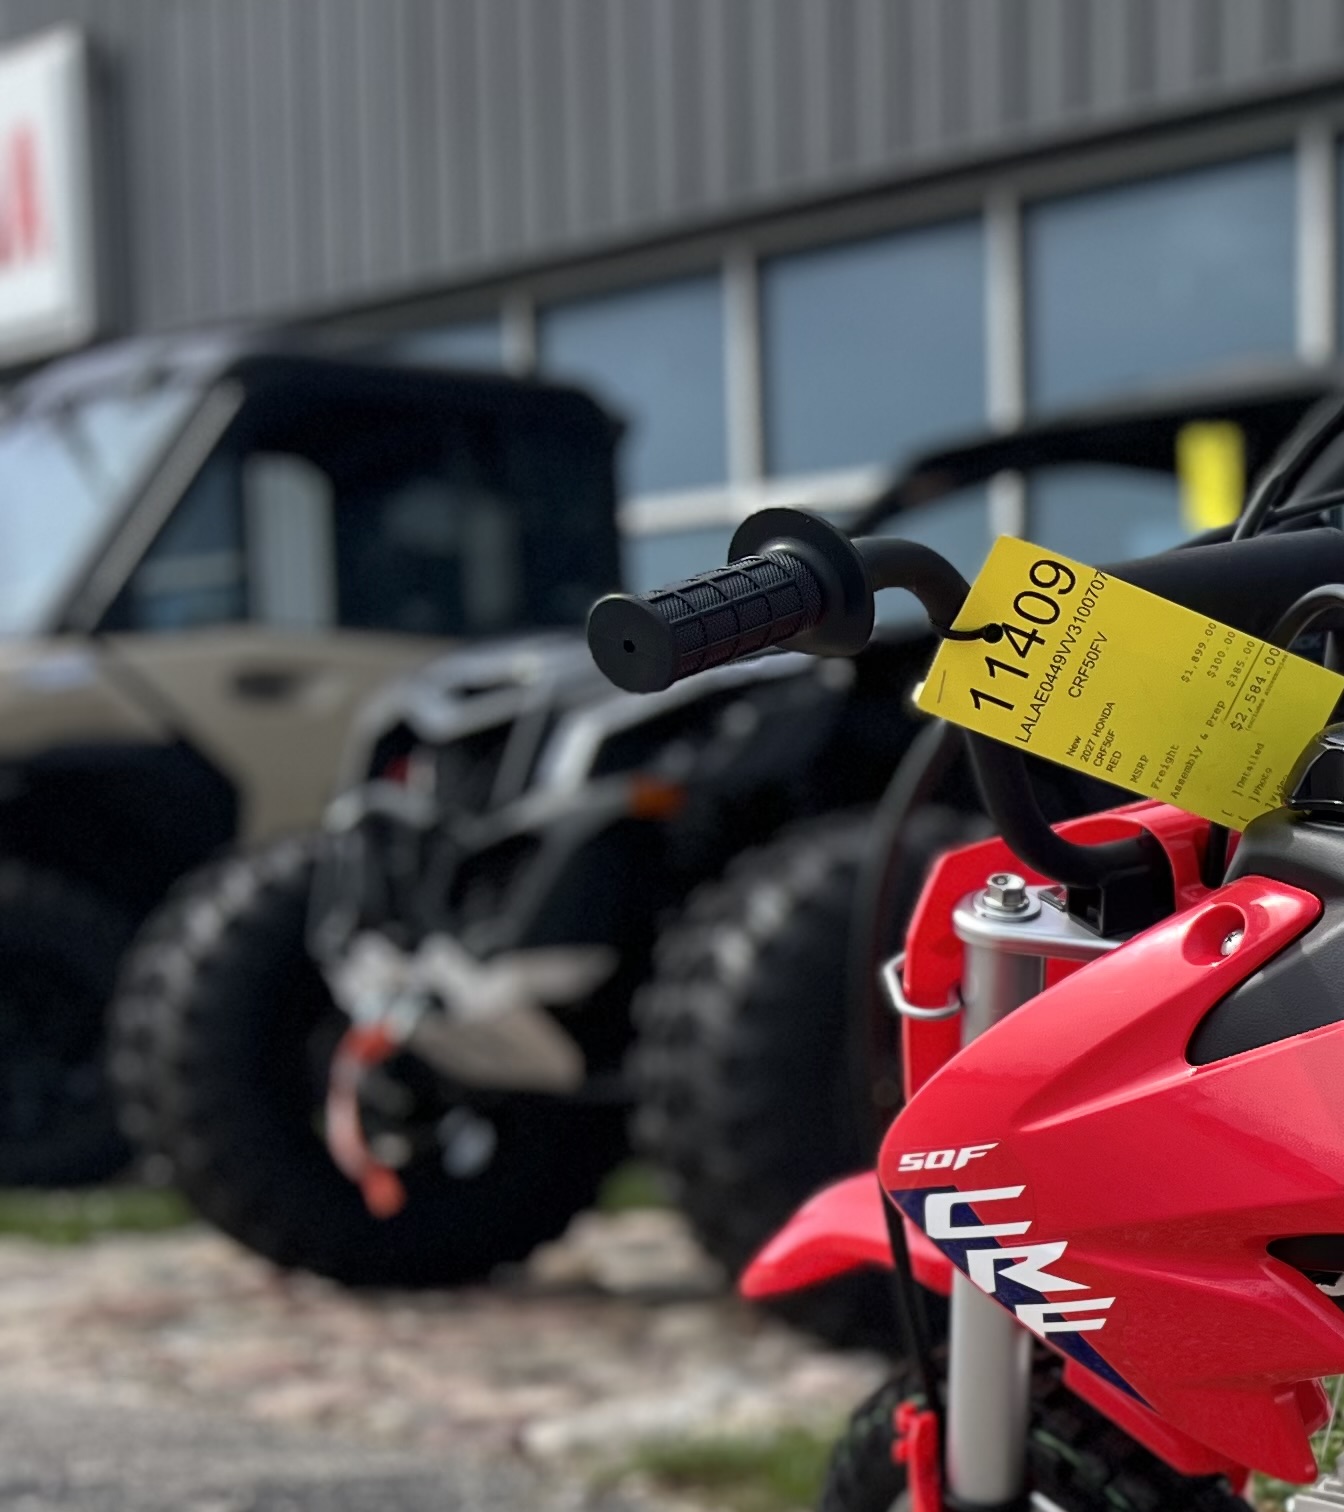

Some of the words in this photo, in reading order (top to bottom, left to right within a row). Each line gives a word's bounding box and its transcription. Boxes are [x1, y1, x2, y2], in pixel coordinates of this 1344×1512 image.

[969, 559, 1075, 710] 11409
[1067, 631, 1107, 697] CRF50FV
[1129, 754, 1148, 783] MSRP
[1180, 622, 1216, 682] $1,899.00
[1150, 744, 1179, 789] Freight
[1206, 631, 1235, 678] $300.00
[1169, 744, 1202, 799] Assembly
[1205, 700, 1225, 727] Prep
[1225, 640, 1255, 687] $385.00
[1229, 647, 1280, 730] $2,584.00
[1065, 735, 1081, 756] New
[1079, 738, 1095, 762] 2027
[1091, 702, 1115, 737] HONDA
[1092, 728, 1115, 766] CRF50F
[1105, 750, 1121, 772] RED
[897, 1142, 1000, 1172] 50F
[924, 1185, 1117, 1340] CRF
